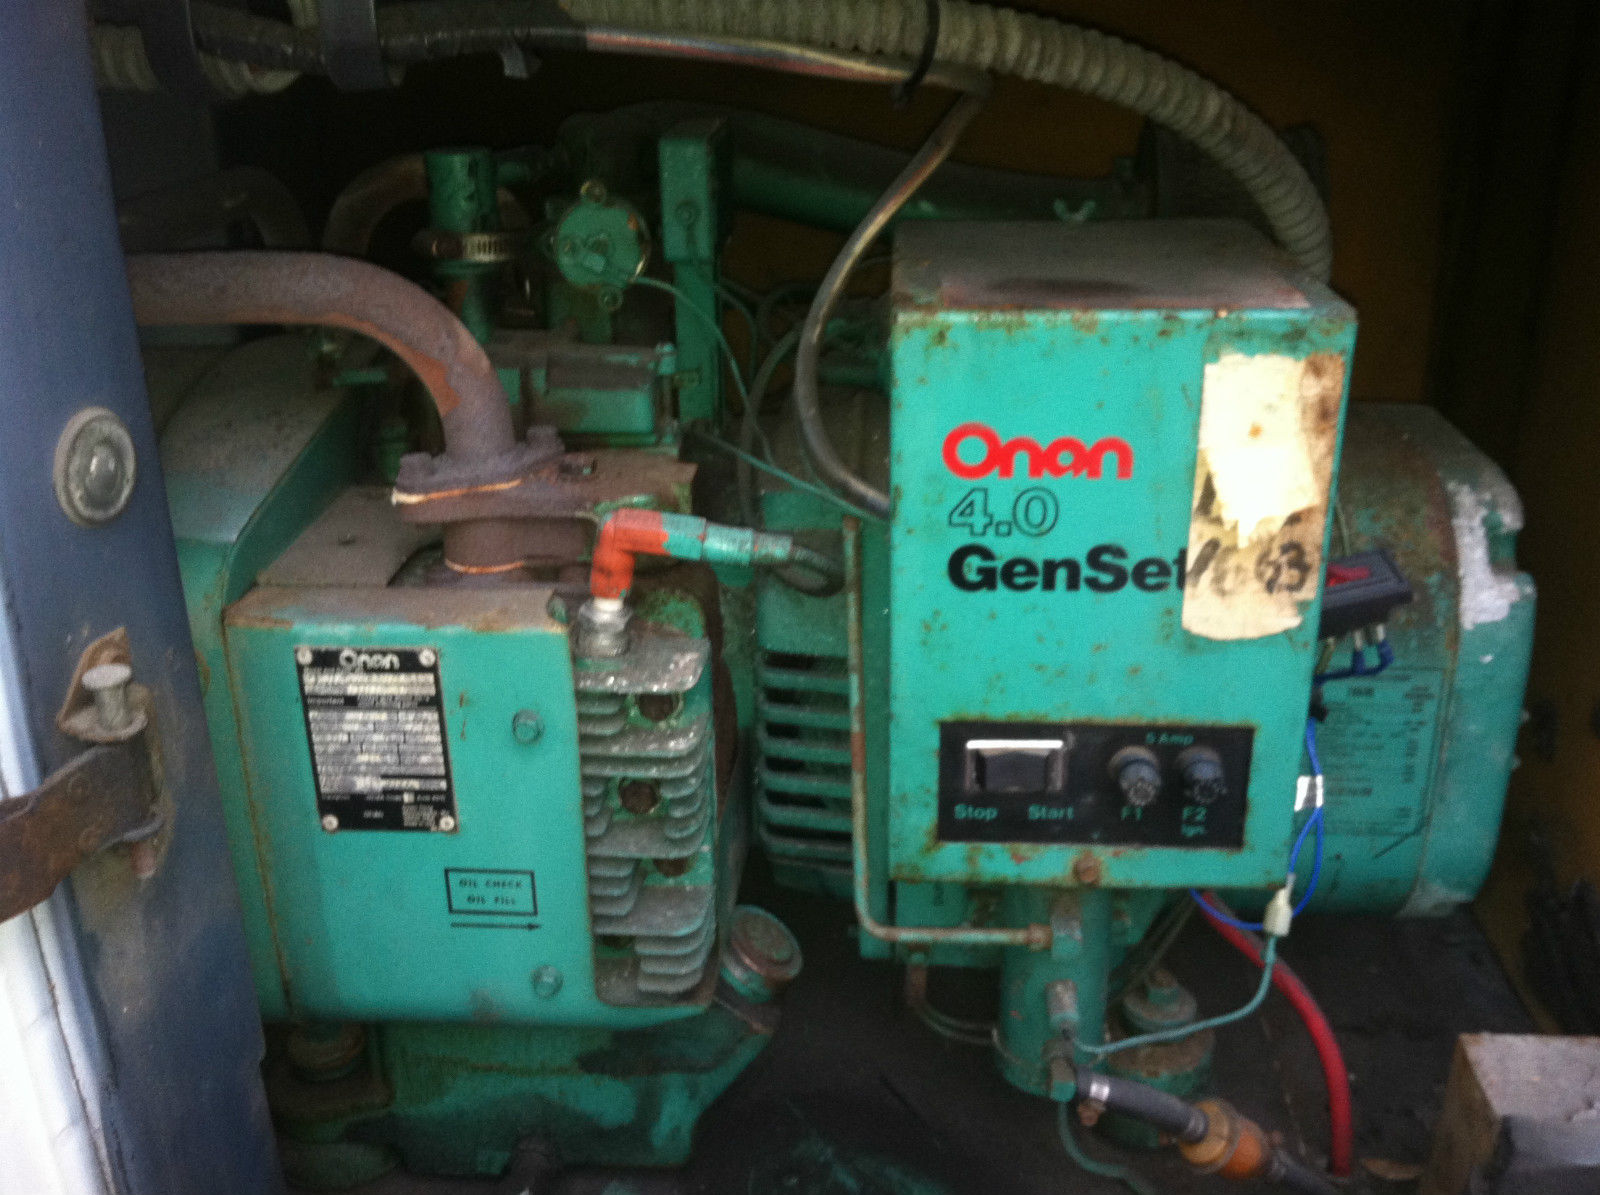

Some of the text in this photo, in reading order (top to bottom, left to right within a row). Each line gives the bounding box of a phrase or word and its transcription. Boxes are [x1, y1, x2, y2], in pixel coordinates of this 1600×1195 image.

[942, 421, 1133, 480] Onan
[949, 487, 1060, 537] 4.0
[339, 649, 400, 671] Onan
[1159, 733, 1195, 745] Amp
[954, 804, 998, 821] Stop
[1028, 805, 1074, 821] Start
[1121, 806, 1143, 821] F1
[1181, 806, 1208, 821] F2
[459, 878, 523, 890] OIL CHECK
[466, 894, 516, 906] OIL FILL
